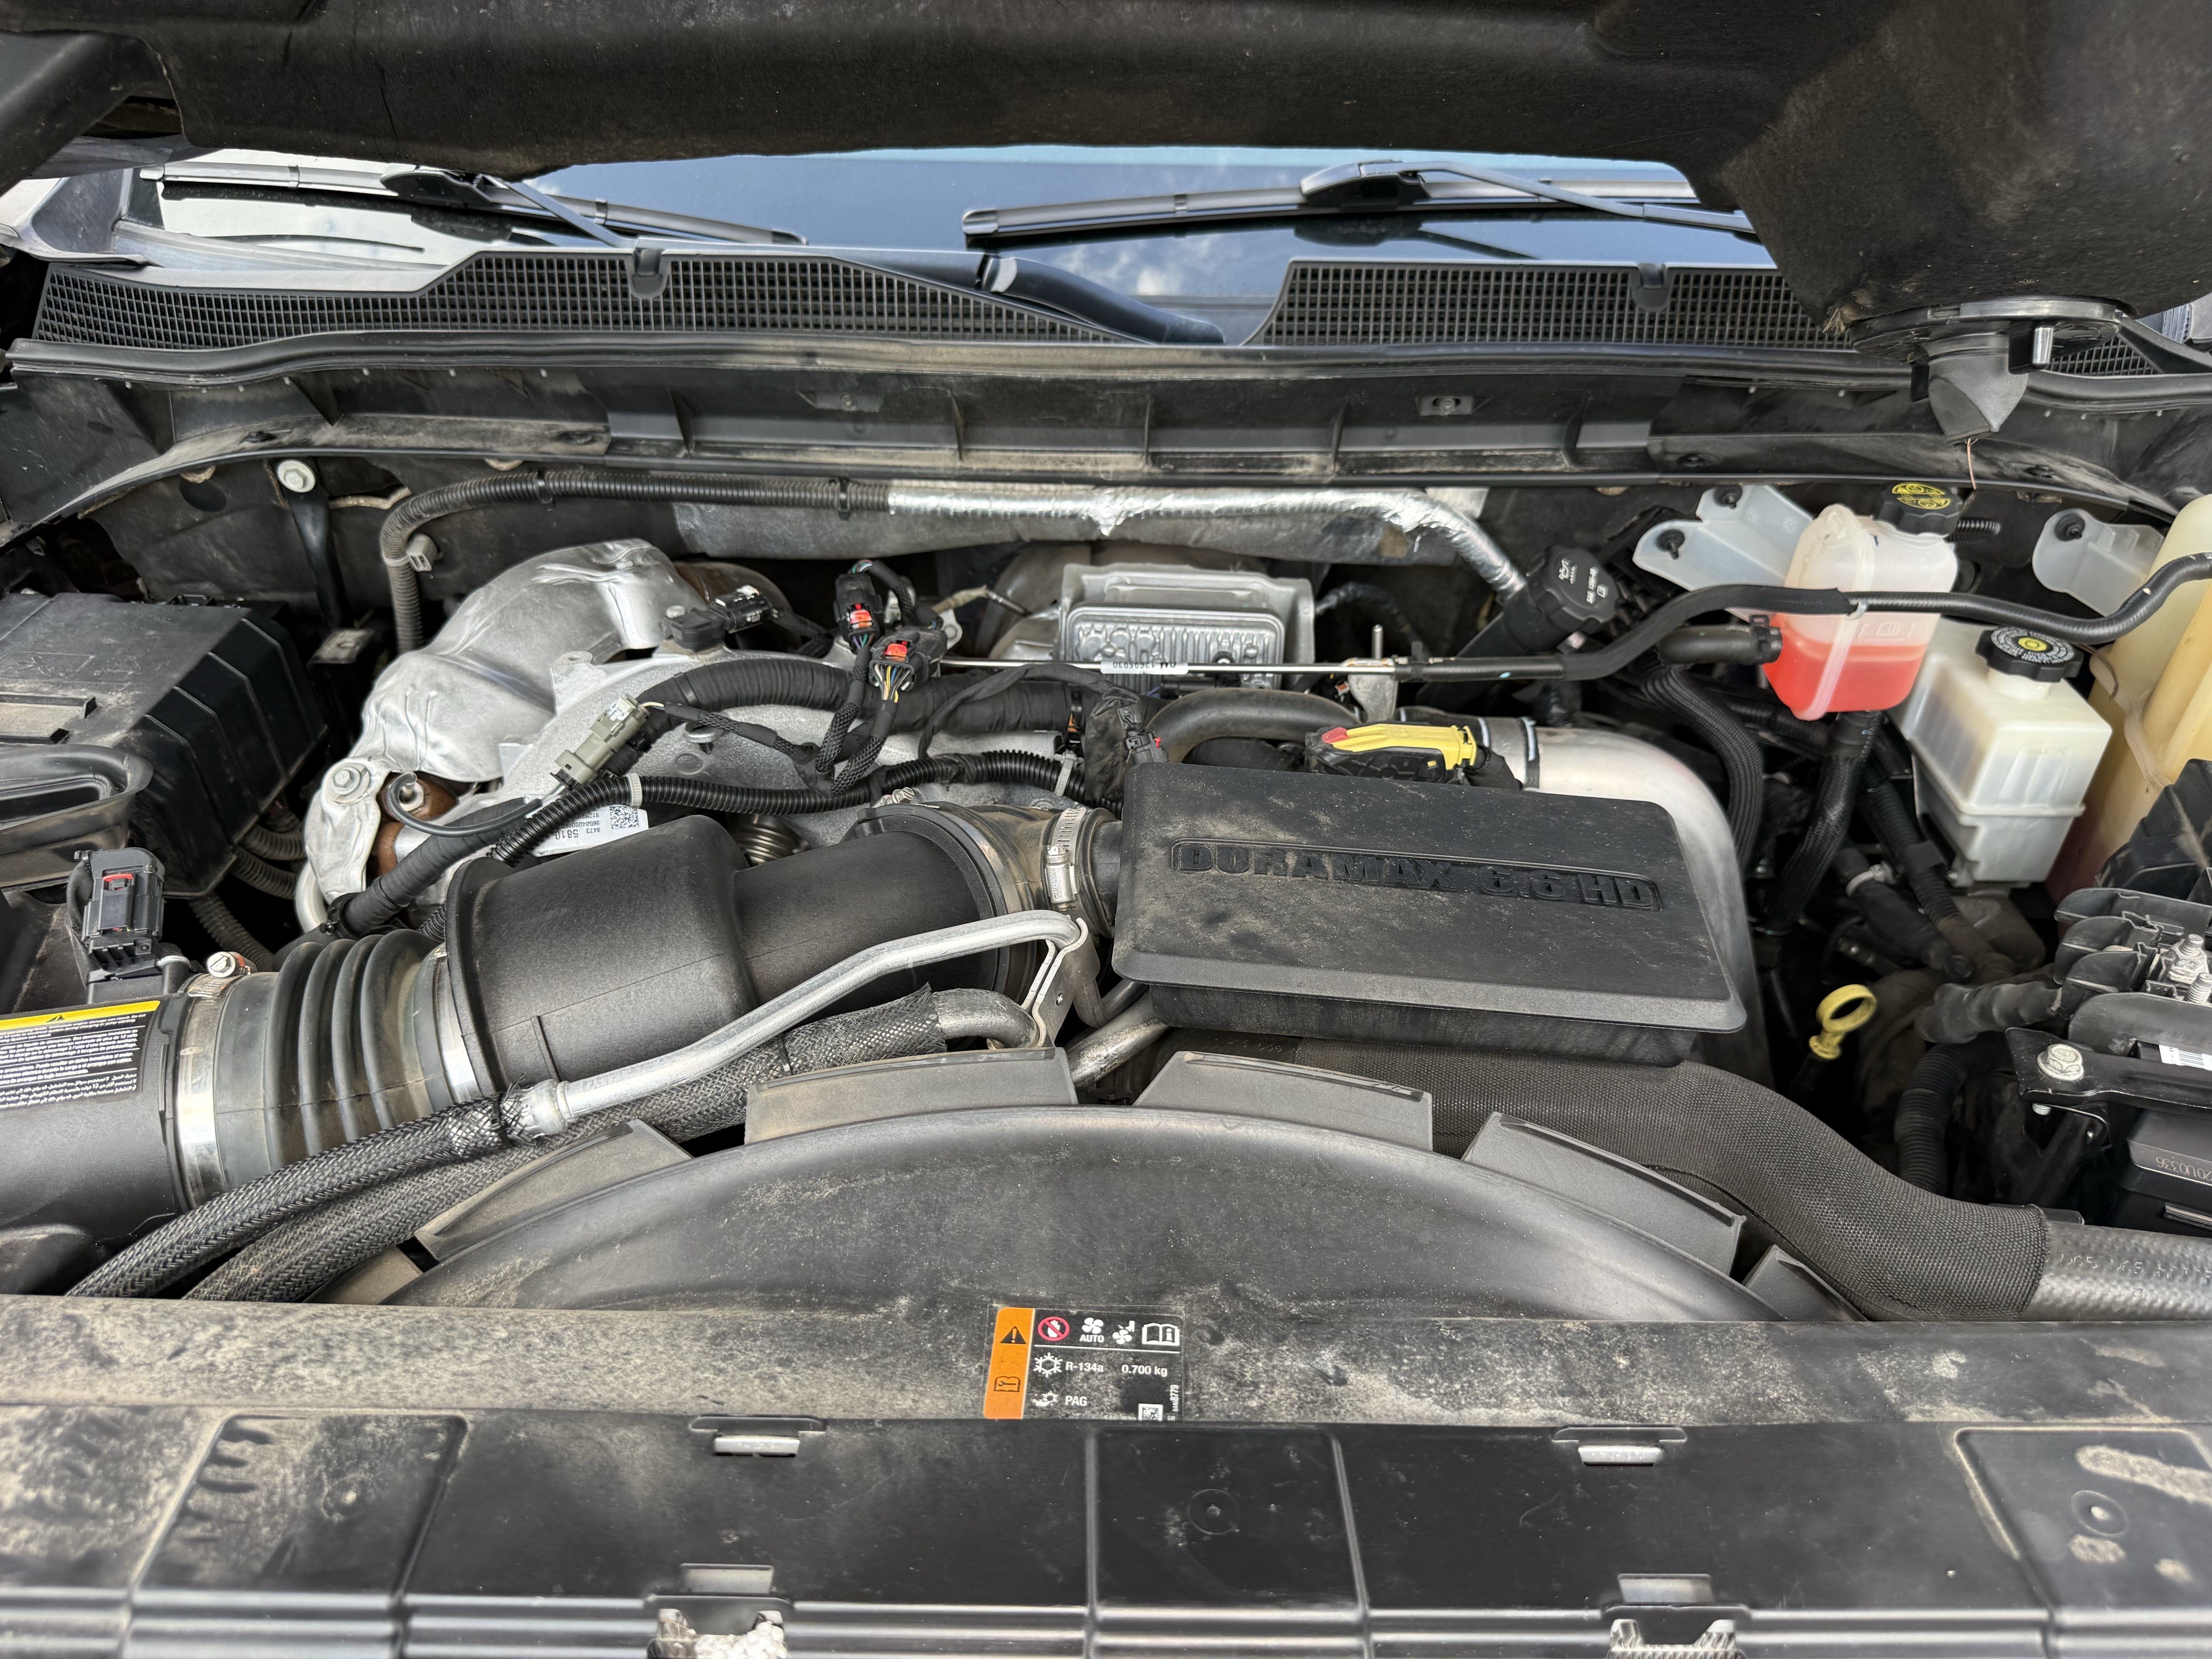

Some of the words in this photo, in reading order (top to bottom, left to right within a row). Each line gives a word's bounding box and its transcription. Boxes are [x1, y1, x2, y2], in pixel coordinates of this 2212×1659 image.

[1178, 844, 1456, 891] DURAMAX
[1577, 874, 1653, 908] HD
[1079, 1334, 1104, 1343] AUTO
[1066, 1362, 1104, 1372] R-134a
[1121, 1364, 1151, 1375] 0.700
[1154, 1365, 1168, 1377] kg
[1065, 1395, 1087, 1406] PAG
